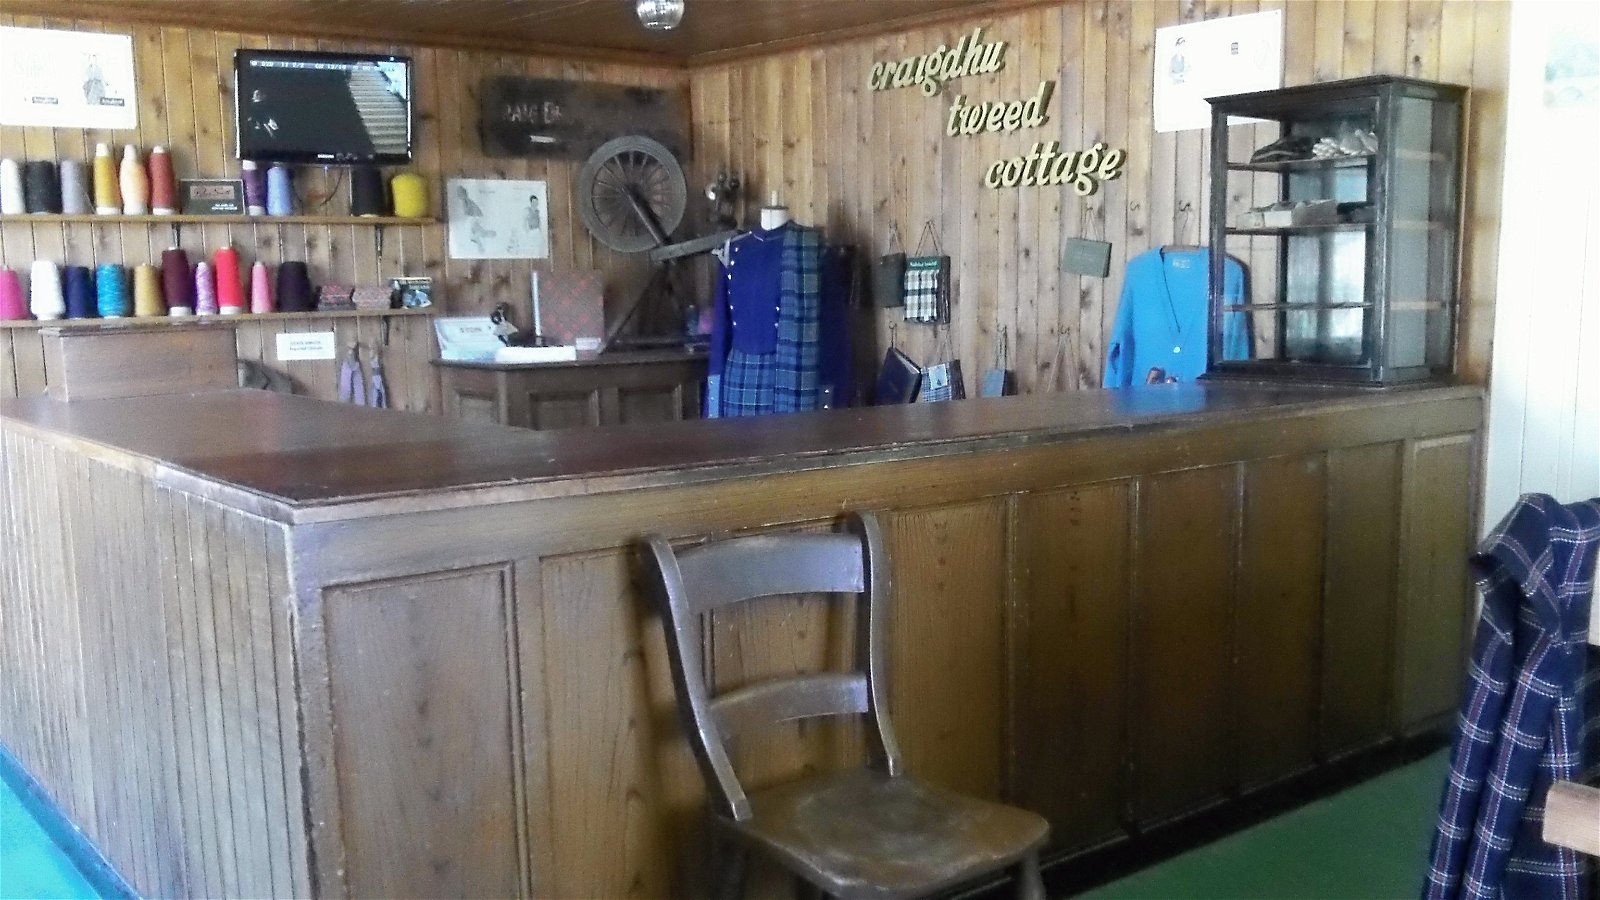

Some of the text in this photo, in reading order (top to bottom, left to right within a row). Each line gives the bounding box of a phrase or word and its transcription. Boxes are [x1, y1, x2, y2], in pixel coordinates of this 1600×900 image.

[869, 27, 1007, 97] craigdhu
[947, 80, 1054, 137] tweed
[986, 141, 1126, 197] cottage
